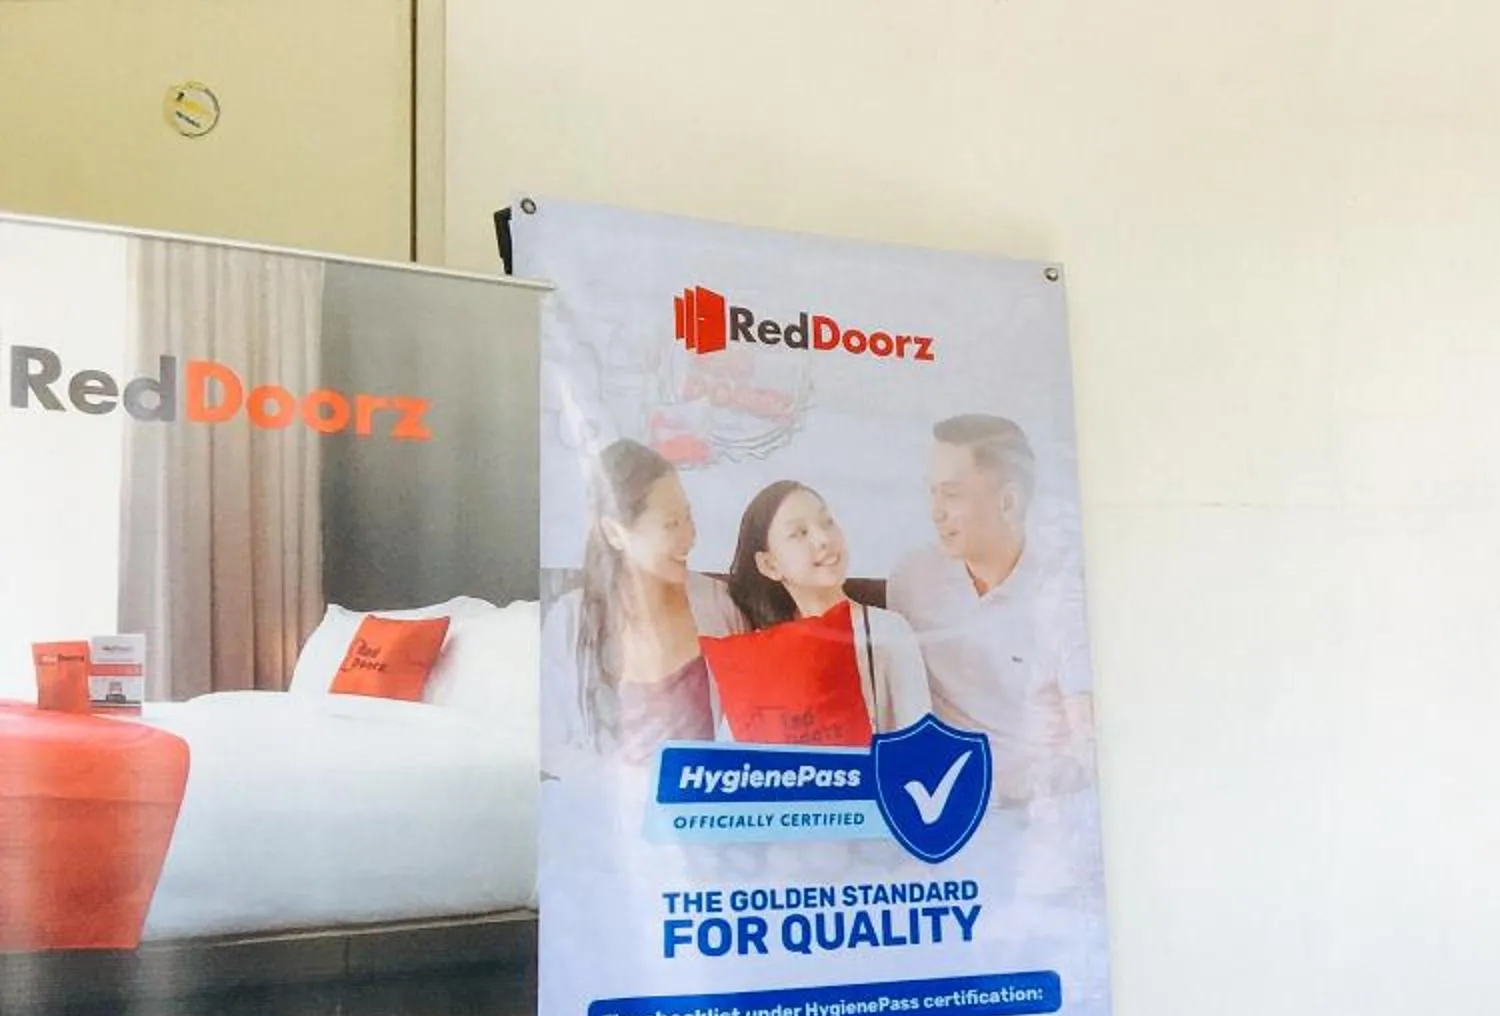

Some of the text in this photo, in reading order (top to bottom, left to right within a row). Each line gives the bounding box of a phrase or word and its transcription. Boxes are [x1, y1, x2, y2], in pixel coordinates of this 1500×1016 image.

[728, 305, 936, 362] RedDoorz
[10, 344, 433, 443] RedDoorz
[678, 762, 862, 794] HygienePass
[672, 811, 865, 830] OFFICIALLY CERTIFIED
[662, 880, 979, 914] THE GOLDEN STANDARD
[662, 905, 983, 959] FOR QUALITY
[923, 987, 1044, 1010] certification:
